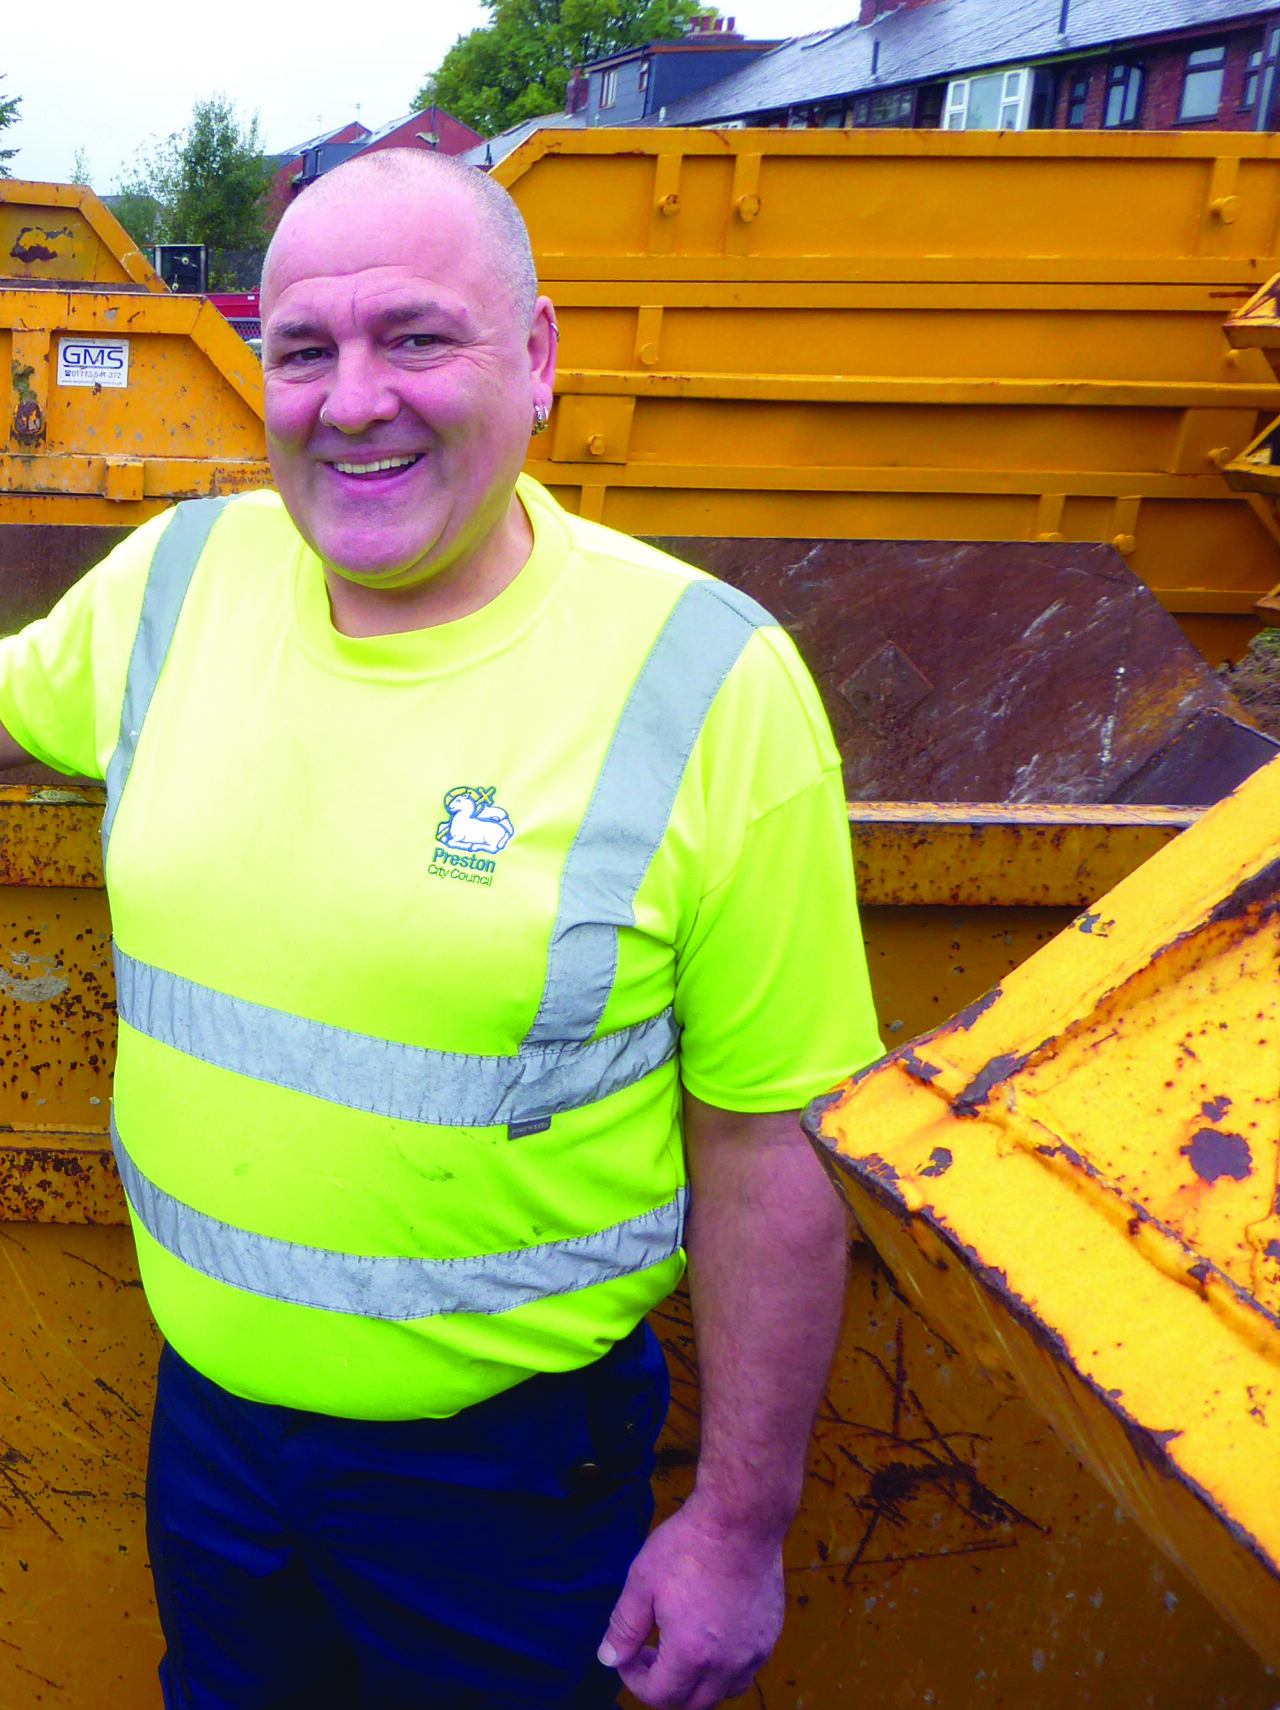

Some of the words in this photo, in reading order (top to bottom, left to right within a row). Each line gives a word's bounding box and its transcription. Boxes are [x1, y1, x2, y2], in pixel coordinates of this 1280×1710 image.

[63, 345, 124, 369] GMS
[432, 847, 496, 873] Preston
[427, 864, 450, 879] City
[450, 868, 493, 886] Council
